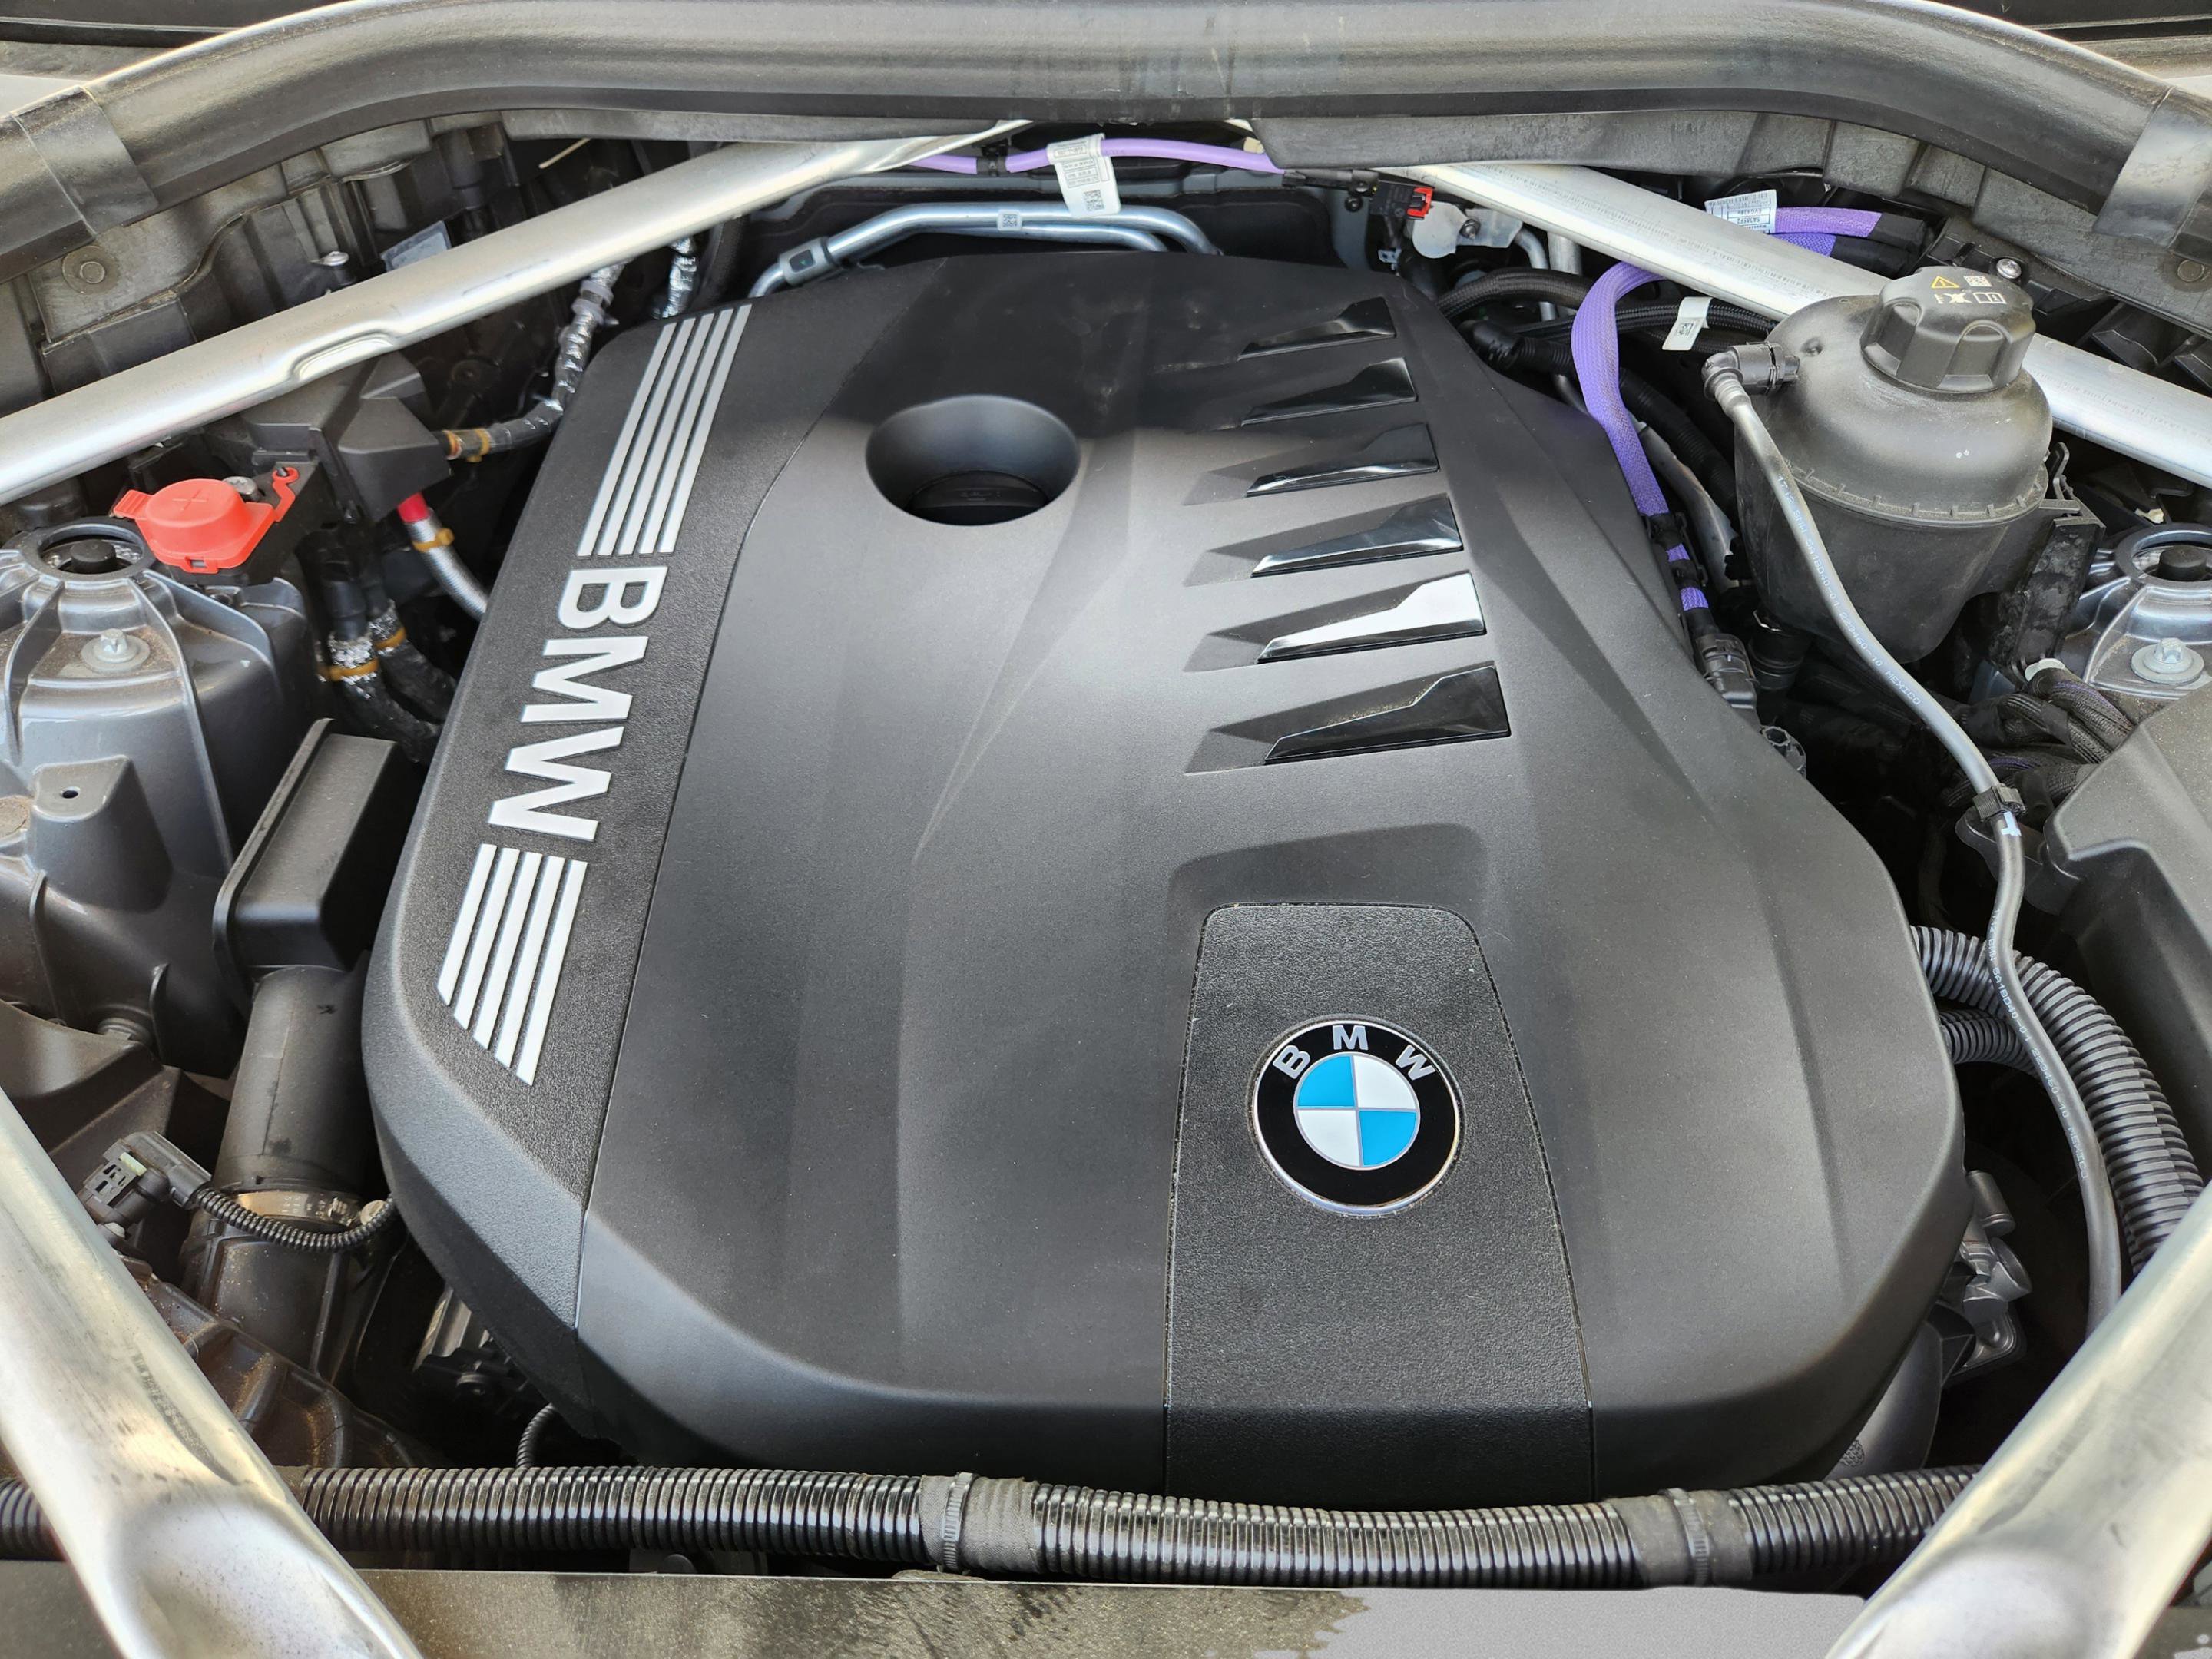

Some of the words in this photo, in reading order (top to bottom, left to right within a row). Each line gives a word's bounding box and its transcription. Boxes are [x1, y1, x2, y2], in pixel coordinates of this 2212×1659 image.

[488, 566, 668, 843] BMW
[1793, 509, 1807, 533] BMW
[1884, 670, 1922, 705] MEXICO
[1272, 1024, 1436, 1081] BMW
[1988, 939, 1997, 962] BMW
[2068, 1127, 2089, 1180] MEXICO
